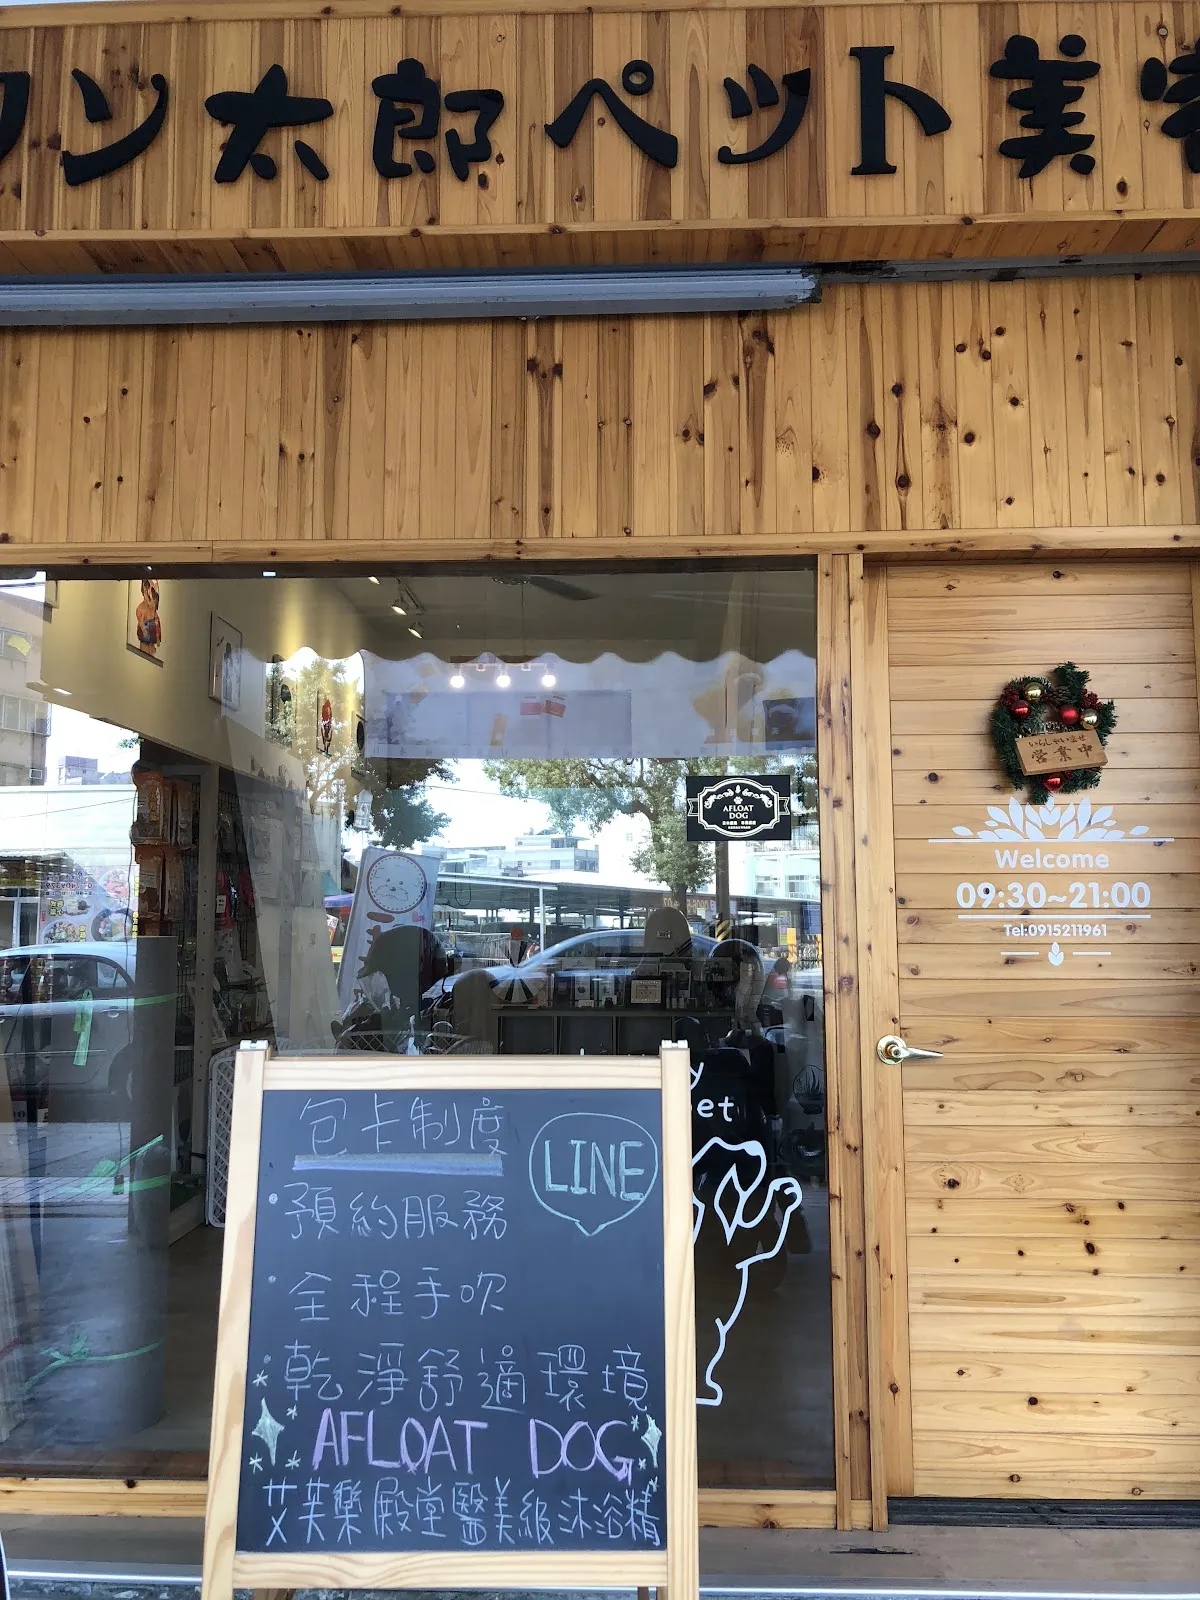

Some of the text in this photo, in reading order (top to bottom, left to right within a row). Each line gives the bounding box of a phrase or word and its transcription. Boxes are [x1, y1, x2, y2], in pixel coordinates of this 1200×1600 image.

[995, 849, 1110, 869] Welcome
[956, 881, 1151, 909] 09:30~21:00
[1004, 924, 1107, 937] Tel:0915211961
[299, 1092, 508, 1159] 包卡制度
[544, 1139, 646, 1201] LINE
[284, 1182, 508, 1240] 預約服務
[288, 1266, 507, 1321] 全程手吹
[284, 1339, 650, 1414] 乾淨舒適環境
[311, 1407, 633, 1486] AFLOAT DOG
